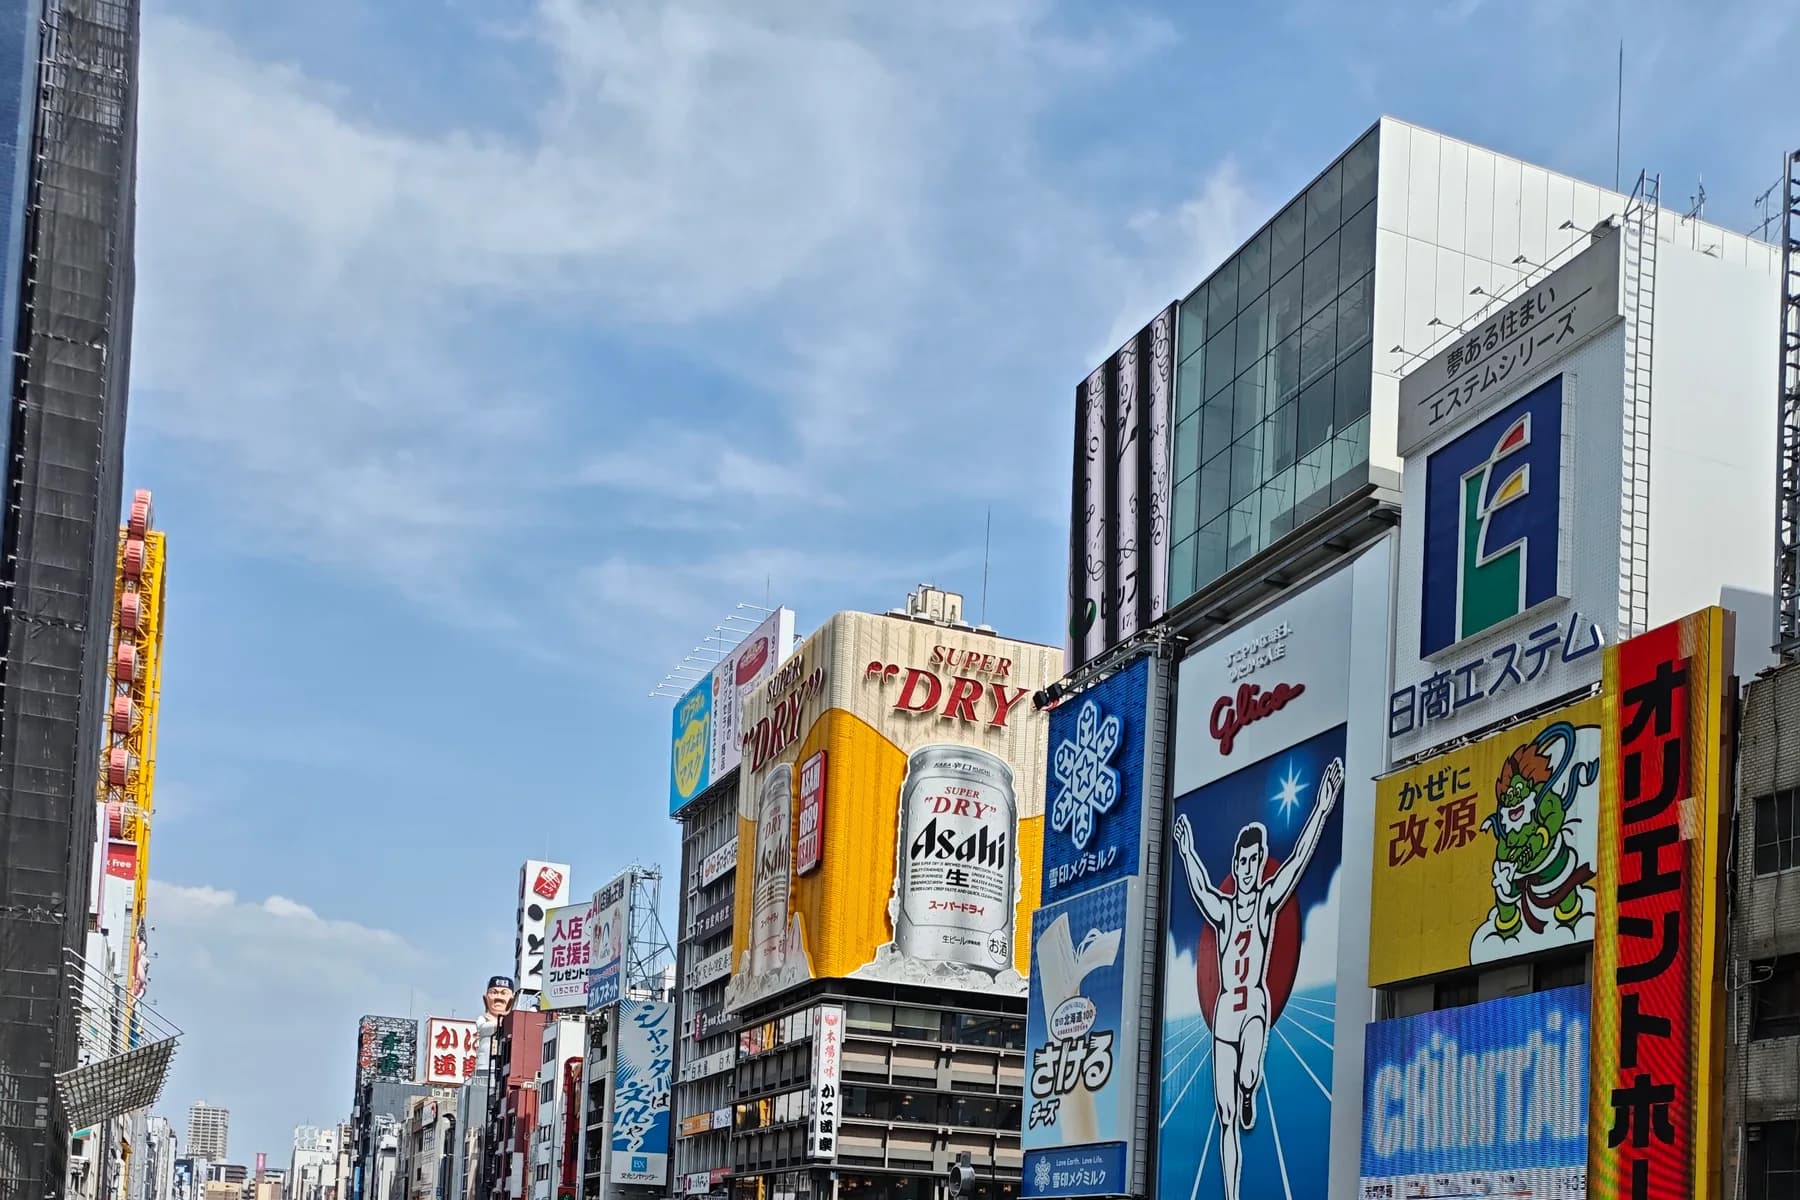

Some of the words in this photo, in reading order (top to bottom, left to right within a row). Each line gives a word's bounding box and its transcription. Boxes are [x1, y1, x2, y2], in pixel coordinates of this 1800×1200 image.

[1447, 288, 1556, 376] 夢ある住まい
[1428, 306, 1577, 426] エステムシリーズ
[767, 654, 803, 703] SUPER
[933, 645, 1012, 677] SUPER
[1389, 612, 1602, 739] 日商エステム
[945, 786, 980, 799] SUPER
[1398, 766, 1471, 811] かぜに
[911, 816, 1005, 871] Asahi
[1388, 792, 1478, 868] 改源
[112, 859, 132, 869] Free
[757, 833, 789, 888] Asahi
[946, 868, 970, 890] 生
[1049, 846, 1117, 889] 雪印メグミルク
[551, 916, 583, 942] 入店
[929, 900, 985, 916] スーパードライ
[942, 935, 966, 946] 生ビール
[1233, 924, 1254, 1012] グリコ
[634, 1004, 671, 1109] シャッターは
[1031, 1030, 1113, 1099] さける
[1029, 1098, 1061, 1130] チーズ
[1053, 1167, 1106, 1189] 雪印メグミルク
